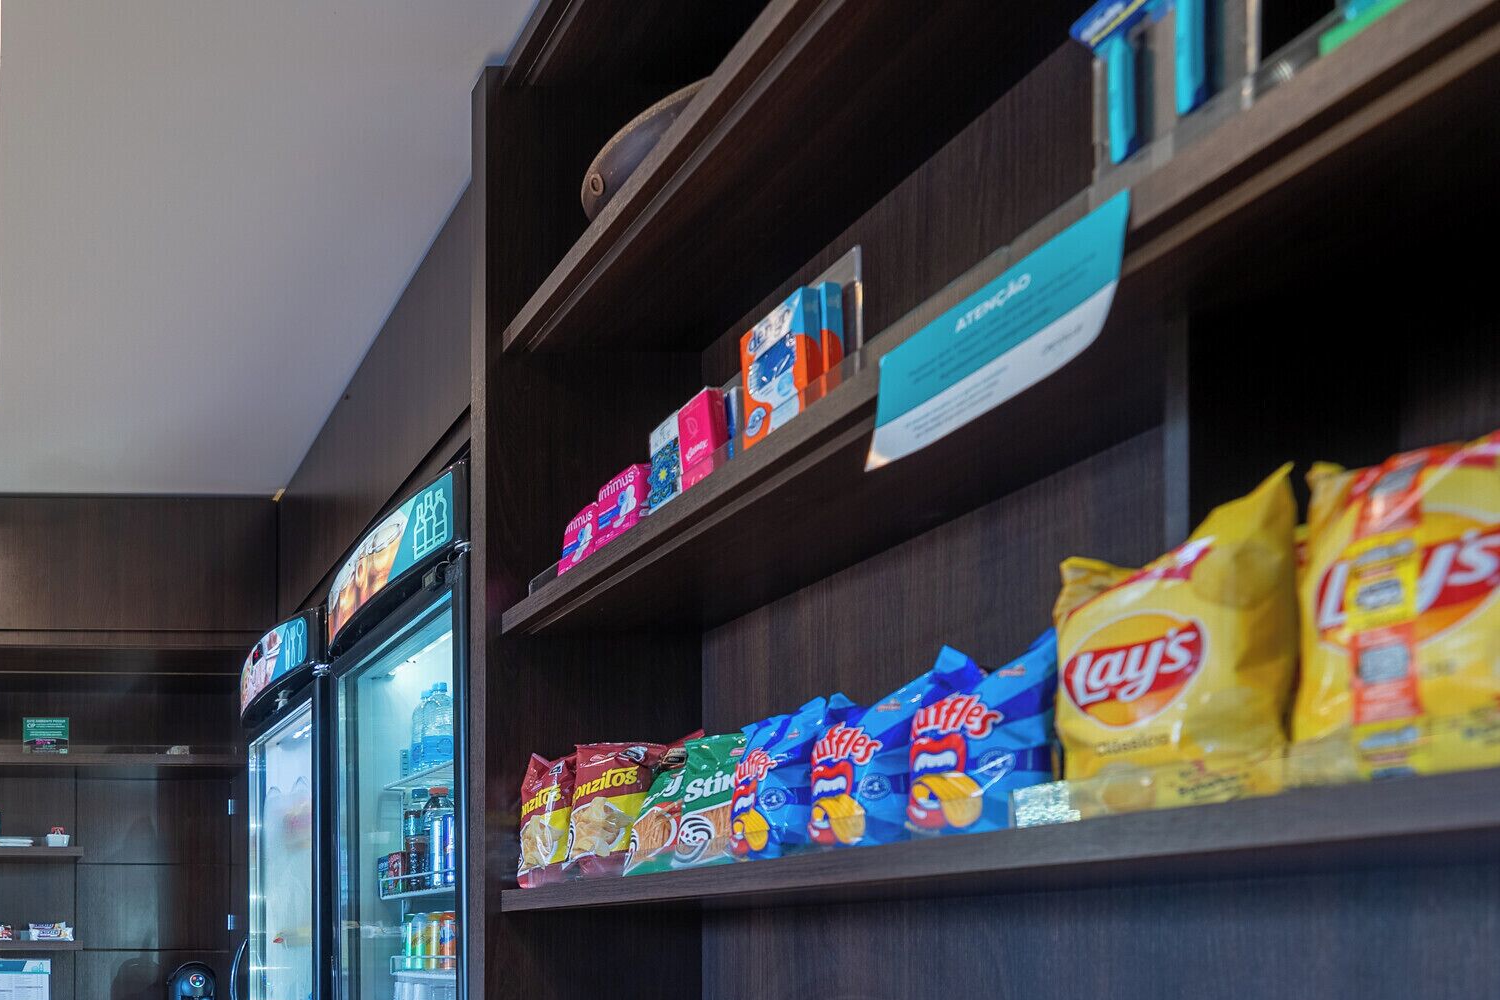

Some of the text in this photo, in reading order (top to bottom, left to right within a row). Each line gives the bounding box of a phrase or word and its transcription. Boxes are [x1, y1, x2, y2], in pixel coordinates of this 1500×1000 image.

[955, 273, 1032, 334] ATENÇÃO
[1319, 530, 1500, 628] Ly's
[1071, 626, 1198, 707] Lay's
[910, 692, 1004, 740] uffles
[735, 747, 778, 784] uffles
[812, 721, 884, 766] uffles
[572, 766, 640, 802] onzitos
